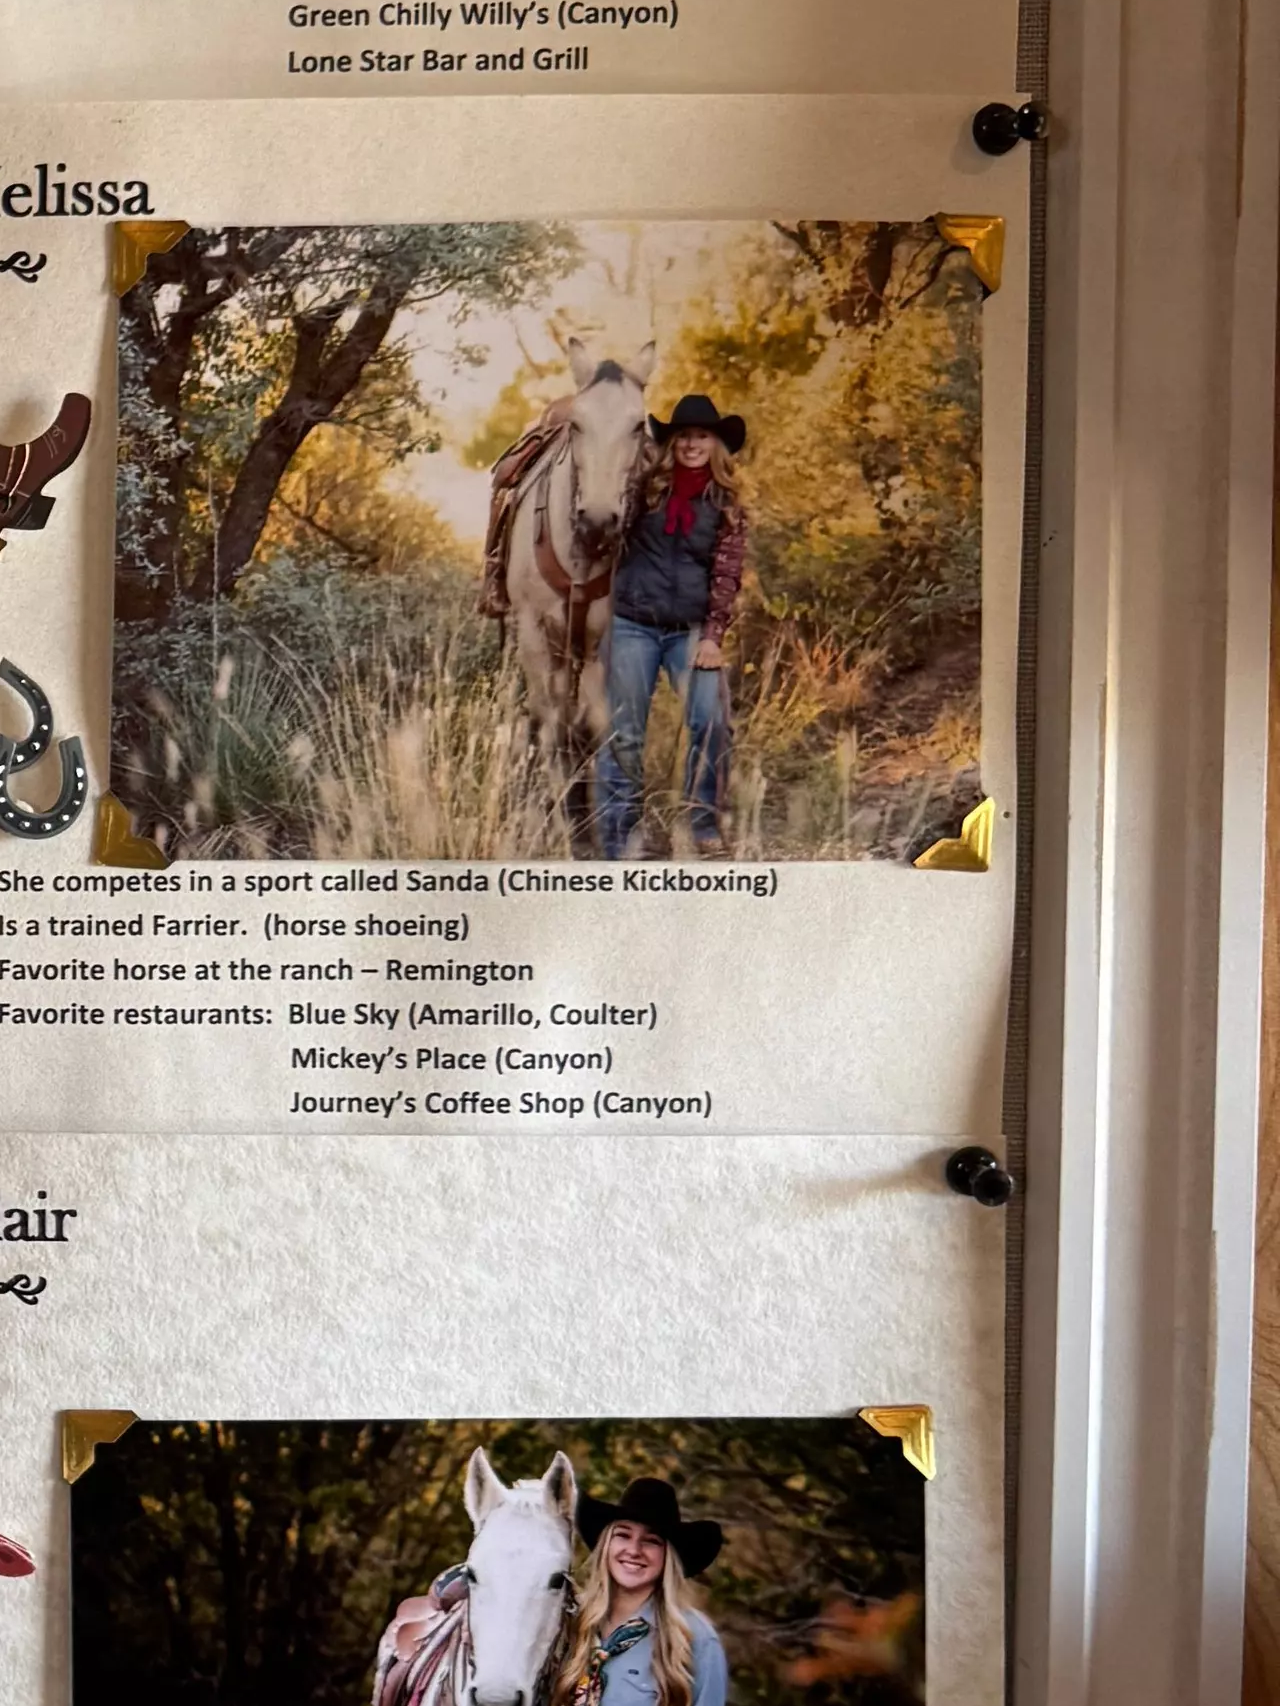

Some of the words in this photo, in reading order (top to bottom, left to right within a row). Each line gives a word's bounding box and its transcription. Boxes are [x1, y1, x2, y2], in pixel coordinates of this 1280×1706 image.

[288, 4, 370, 28] Green
[379, 1, 453, 31] Chilly
[459, 0, 550, 31] Willy's
[558, 0, 679, 30] (Canyon)
[25, 919, 40, 937] a
[47, 913, 144, 937] trained
[152, 913, 248, 937] Farrier.
[264, 912, 347, 942] (horse
[354, 912, 470, 942] shoeing)
[291, 1046, 408, 1075] Mickey's
[416, 1046, 487, 1070] Place
[495, 1046, 613, 1075] (Canyon)
[289, 1090, 417, 1119] Journey's
[424, 1091, 512, 1115] Coffee
[519, 1091, 585, 1119] Shop
[593, 1090, 712, 1119] (Canyon)
